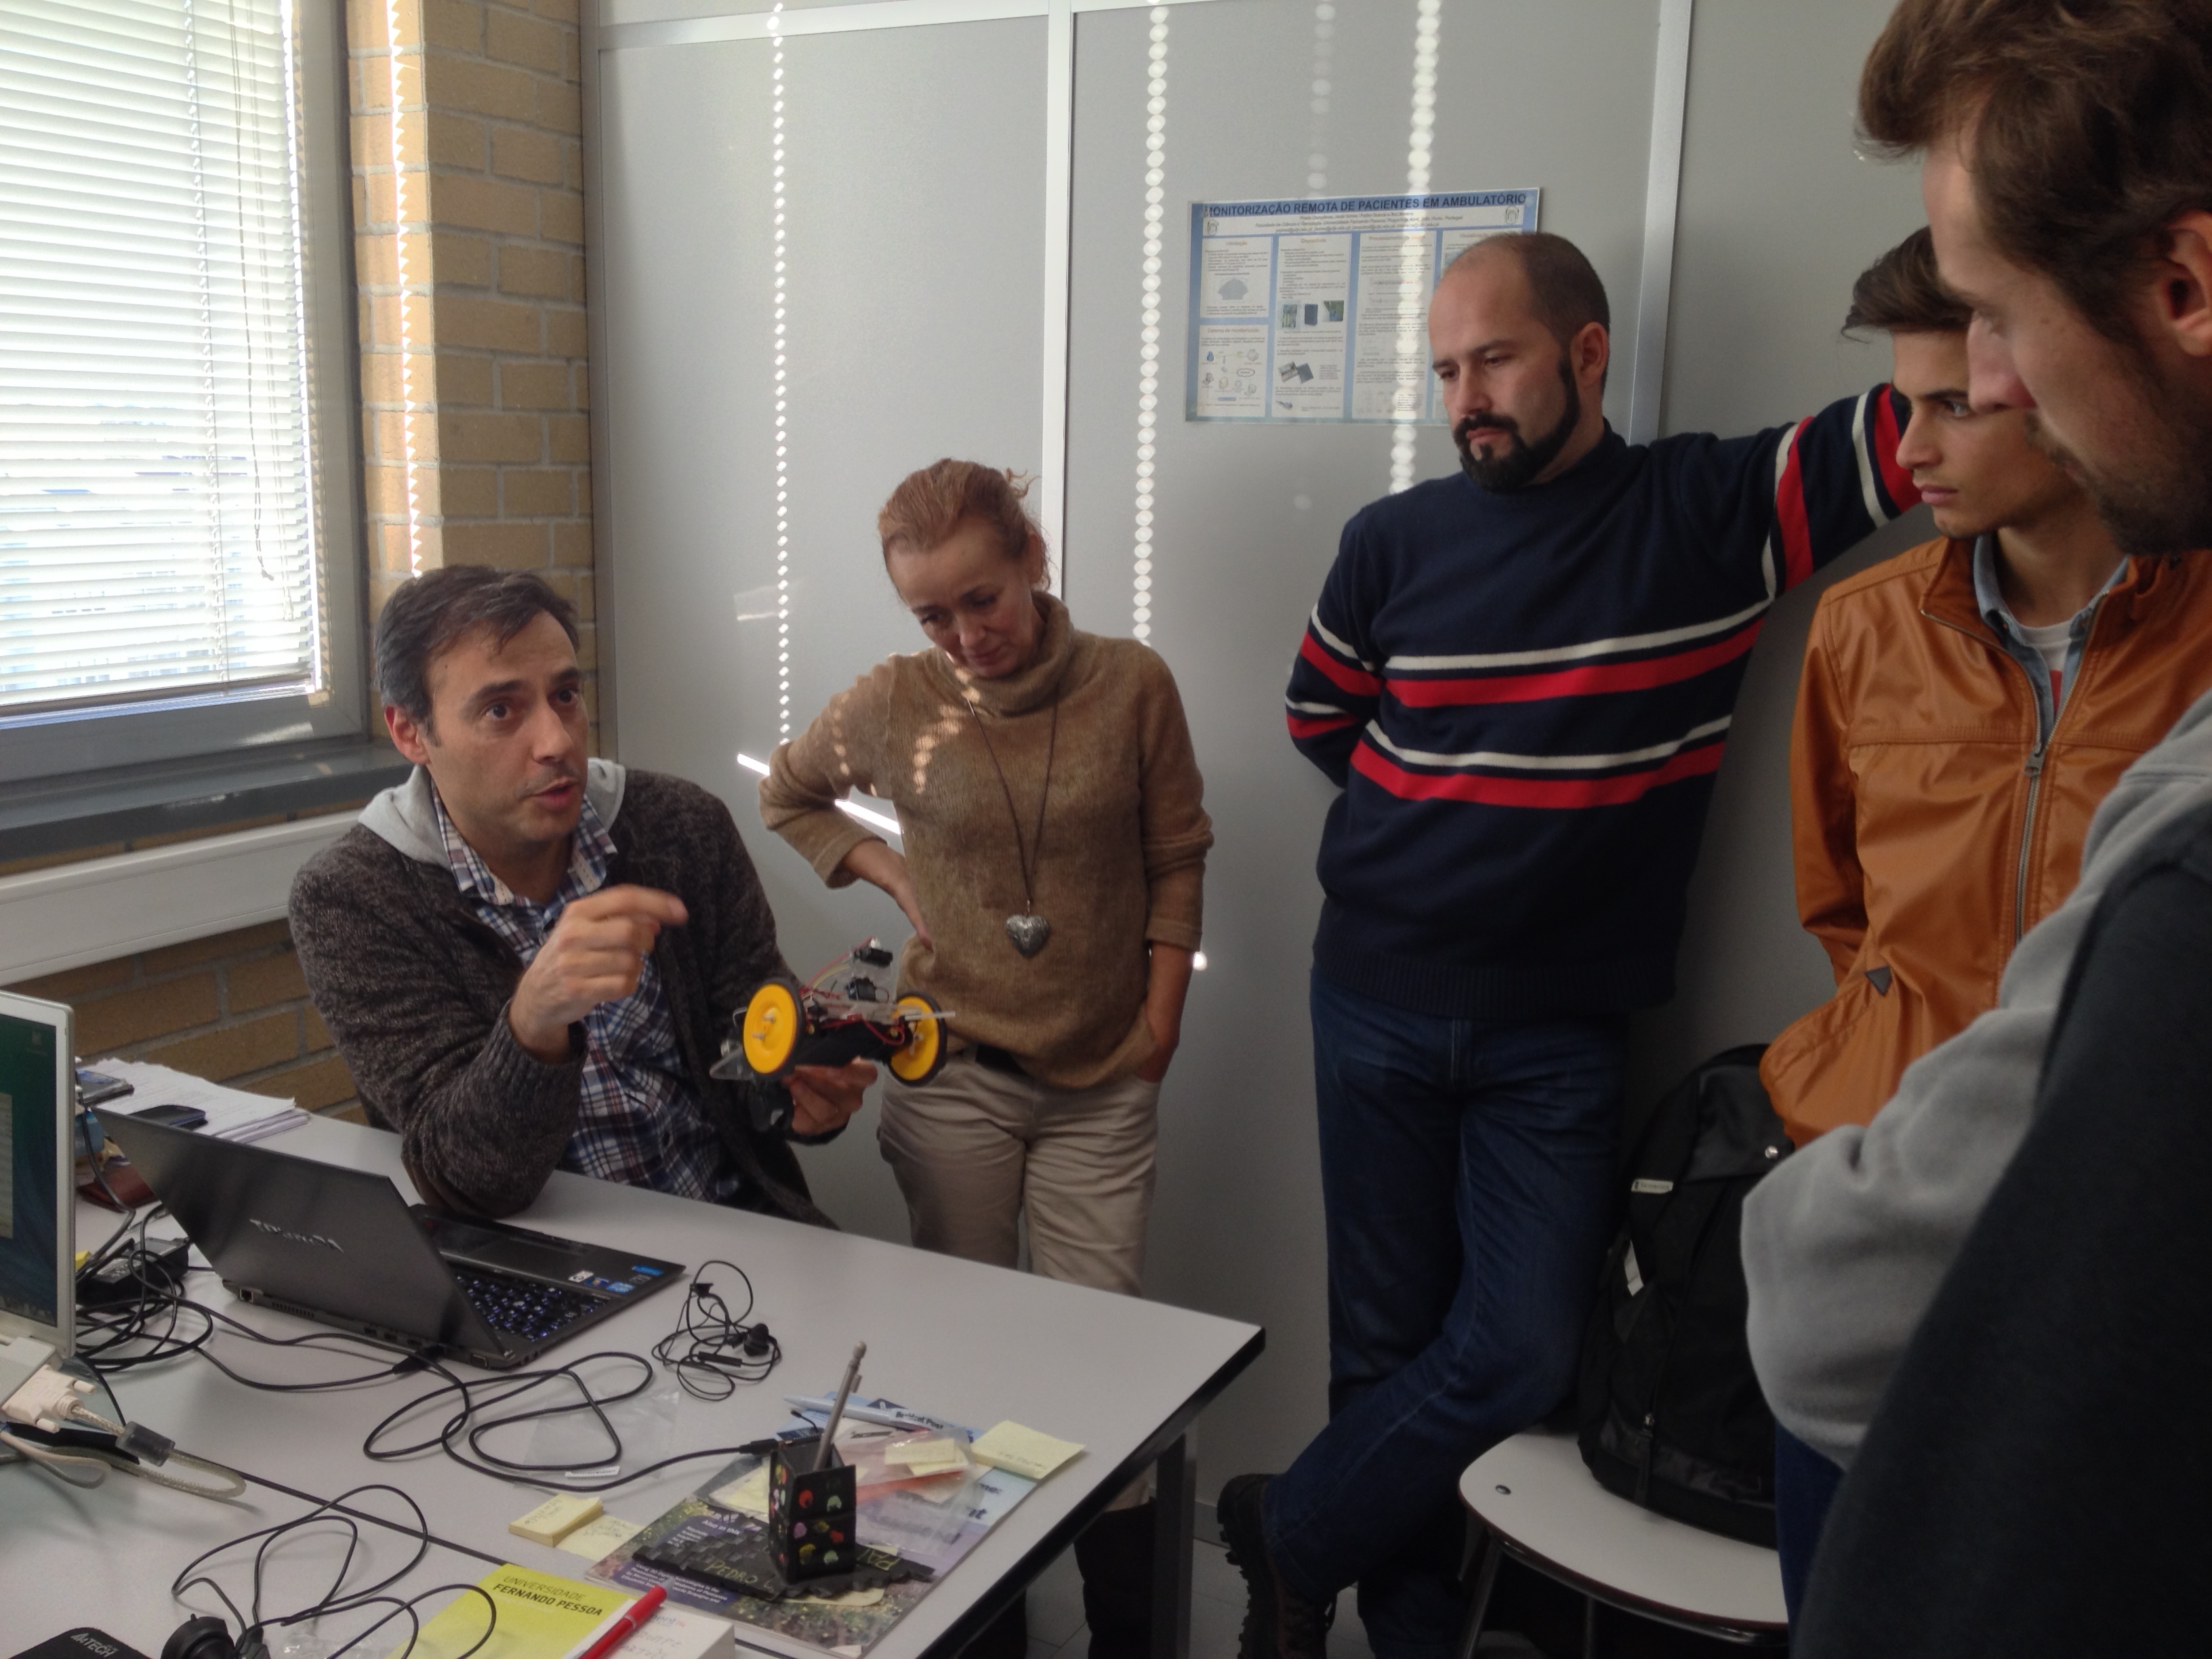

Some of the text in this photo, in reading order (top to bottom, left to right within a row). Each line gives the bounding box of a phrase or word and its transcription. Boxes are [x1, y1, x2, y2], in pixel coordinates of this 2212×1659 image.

[1293, 201, 1338, 213] REMOTA
[1340, 201, 1355, 211] DE
[1358, 198, 1420, 210] PACIENTES
[1422, 197, 1439, 207] EM
[1442, 192, 1526, 207] AMBULATÓRIO
[926, 1418, 943, 1430] Post
[704, 1559, 758, 1584] PEDRO
[493, 1584, 556, 1605] FERNANDO
[556, 1600, 603, 1616] PESSOA
[503, 1576, 588, 1601] UNIVERSIDADE
